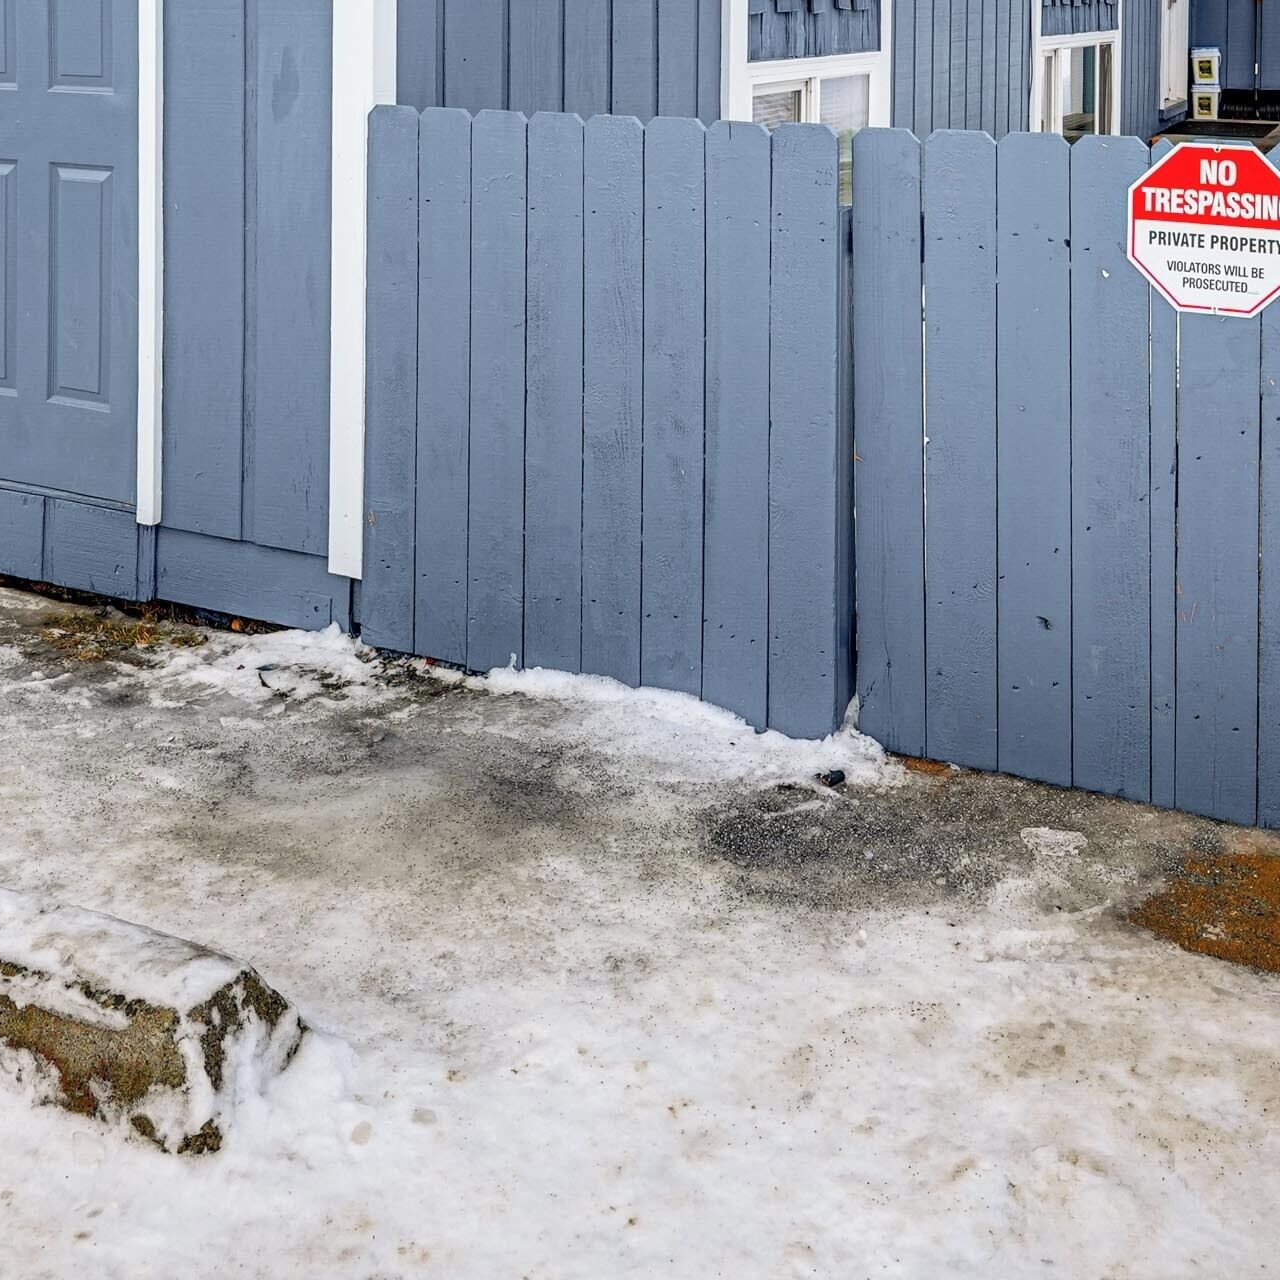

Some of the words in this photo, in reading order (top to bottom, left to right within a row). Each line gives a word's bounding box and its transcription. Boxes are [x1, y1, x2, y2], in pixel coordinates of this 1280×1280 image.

[1199, 158, 1237, 187] NO
[1148, 230, 1205, 249] PRIVATE
[1166, 260, 1221, 276] VIOLATORS
[1224, 265, 1249, 279] WILL
[1251, 267, 1265, 280] BE
[1182, 277, 1248, 294] PROSECUTED
